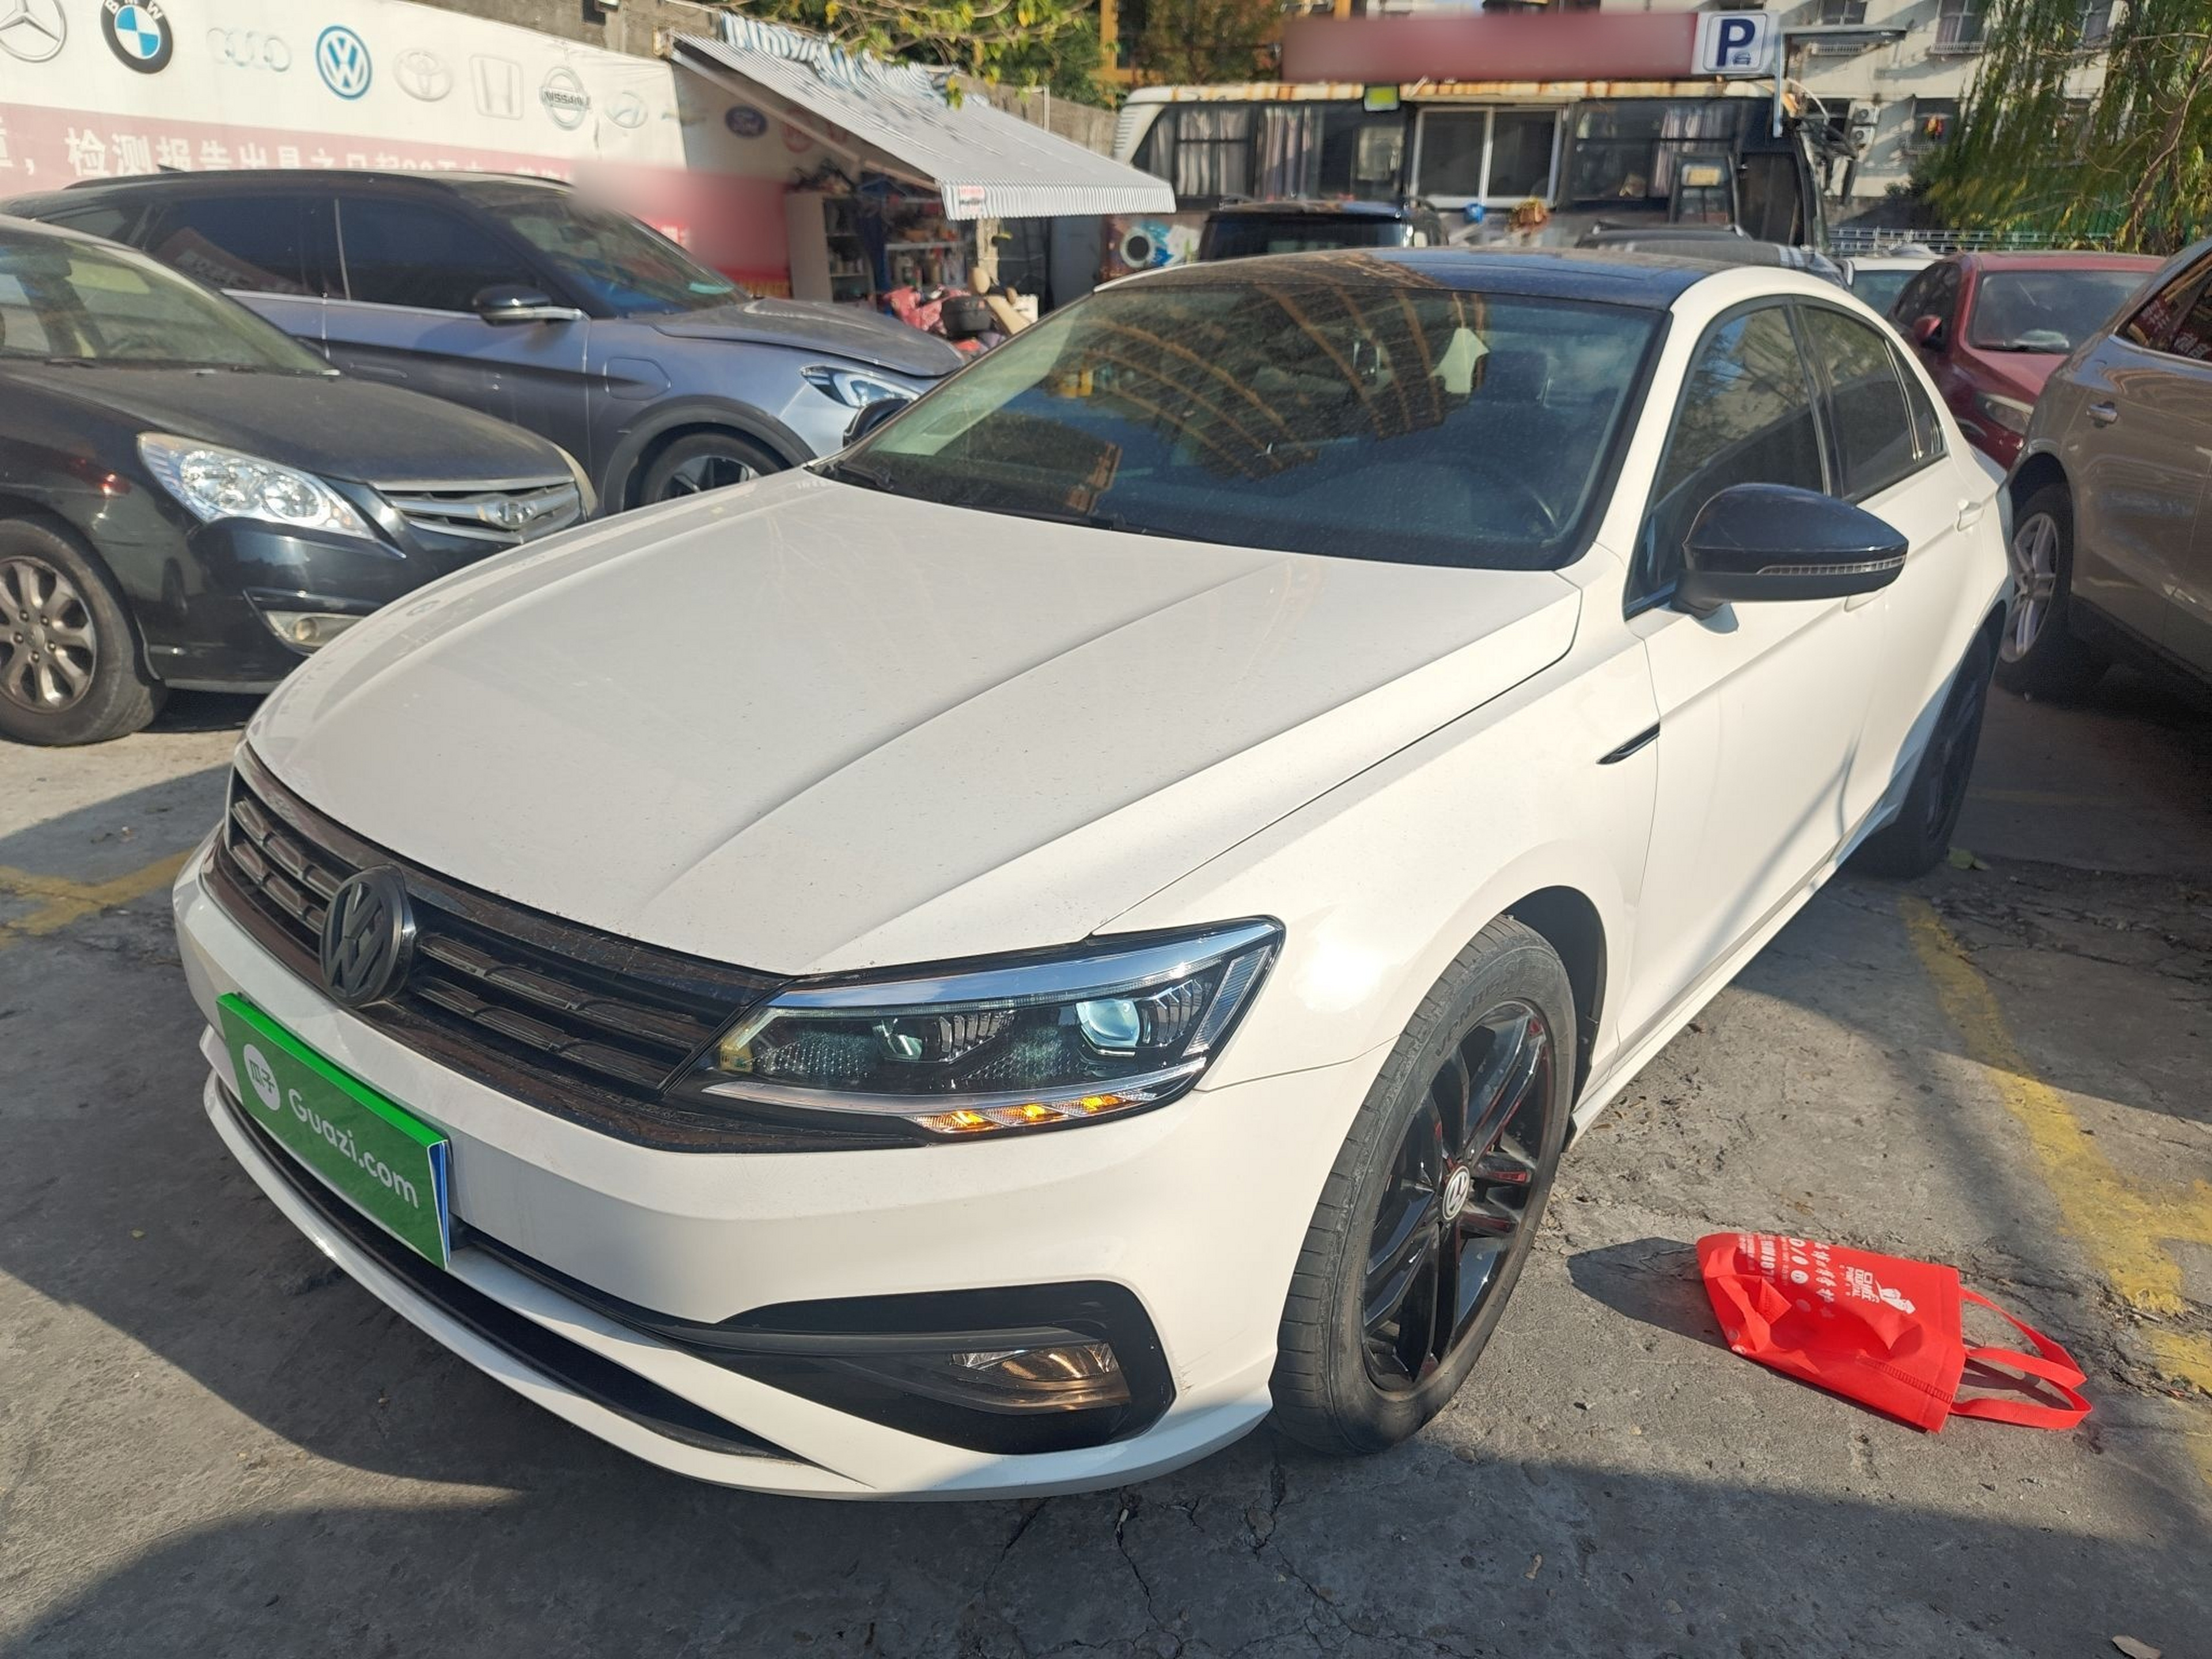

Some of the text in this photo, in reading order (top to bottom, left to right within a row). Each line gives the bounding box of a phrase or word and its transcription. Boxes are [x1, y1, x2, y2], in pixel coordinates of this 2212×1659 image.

[1716, 18, 1756, 67] P
[543, 90, 584, 106] NISSAN
[248, 1058, 275, 1094] 瓜子
[288, 1088, 419, 1209] Guazi.com
